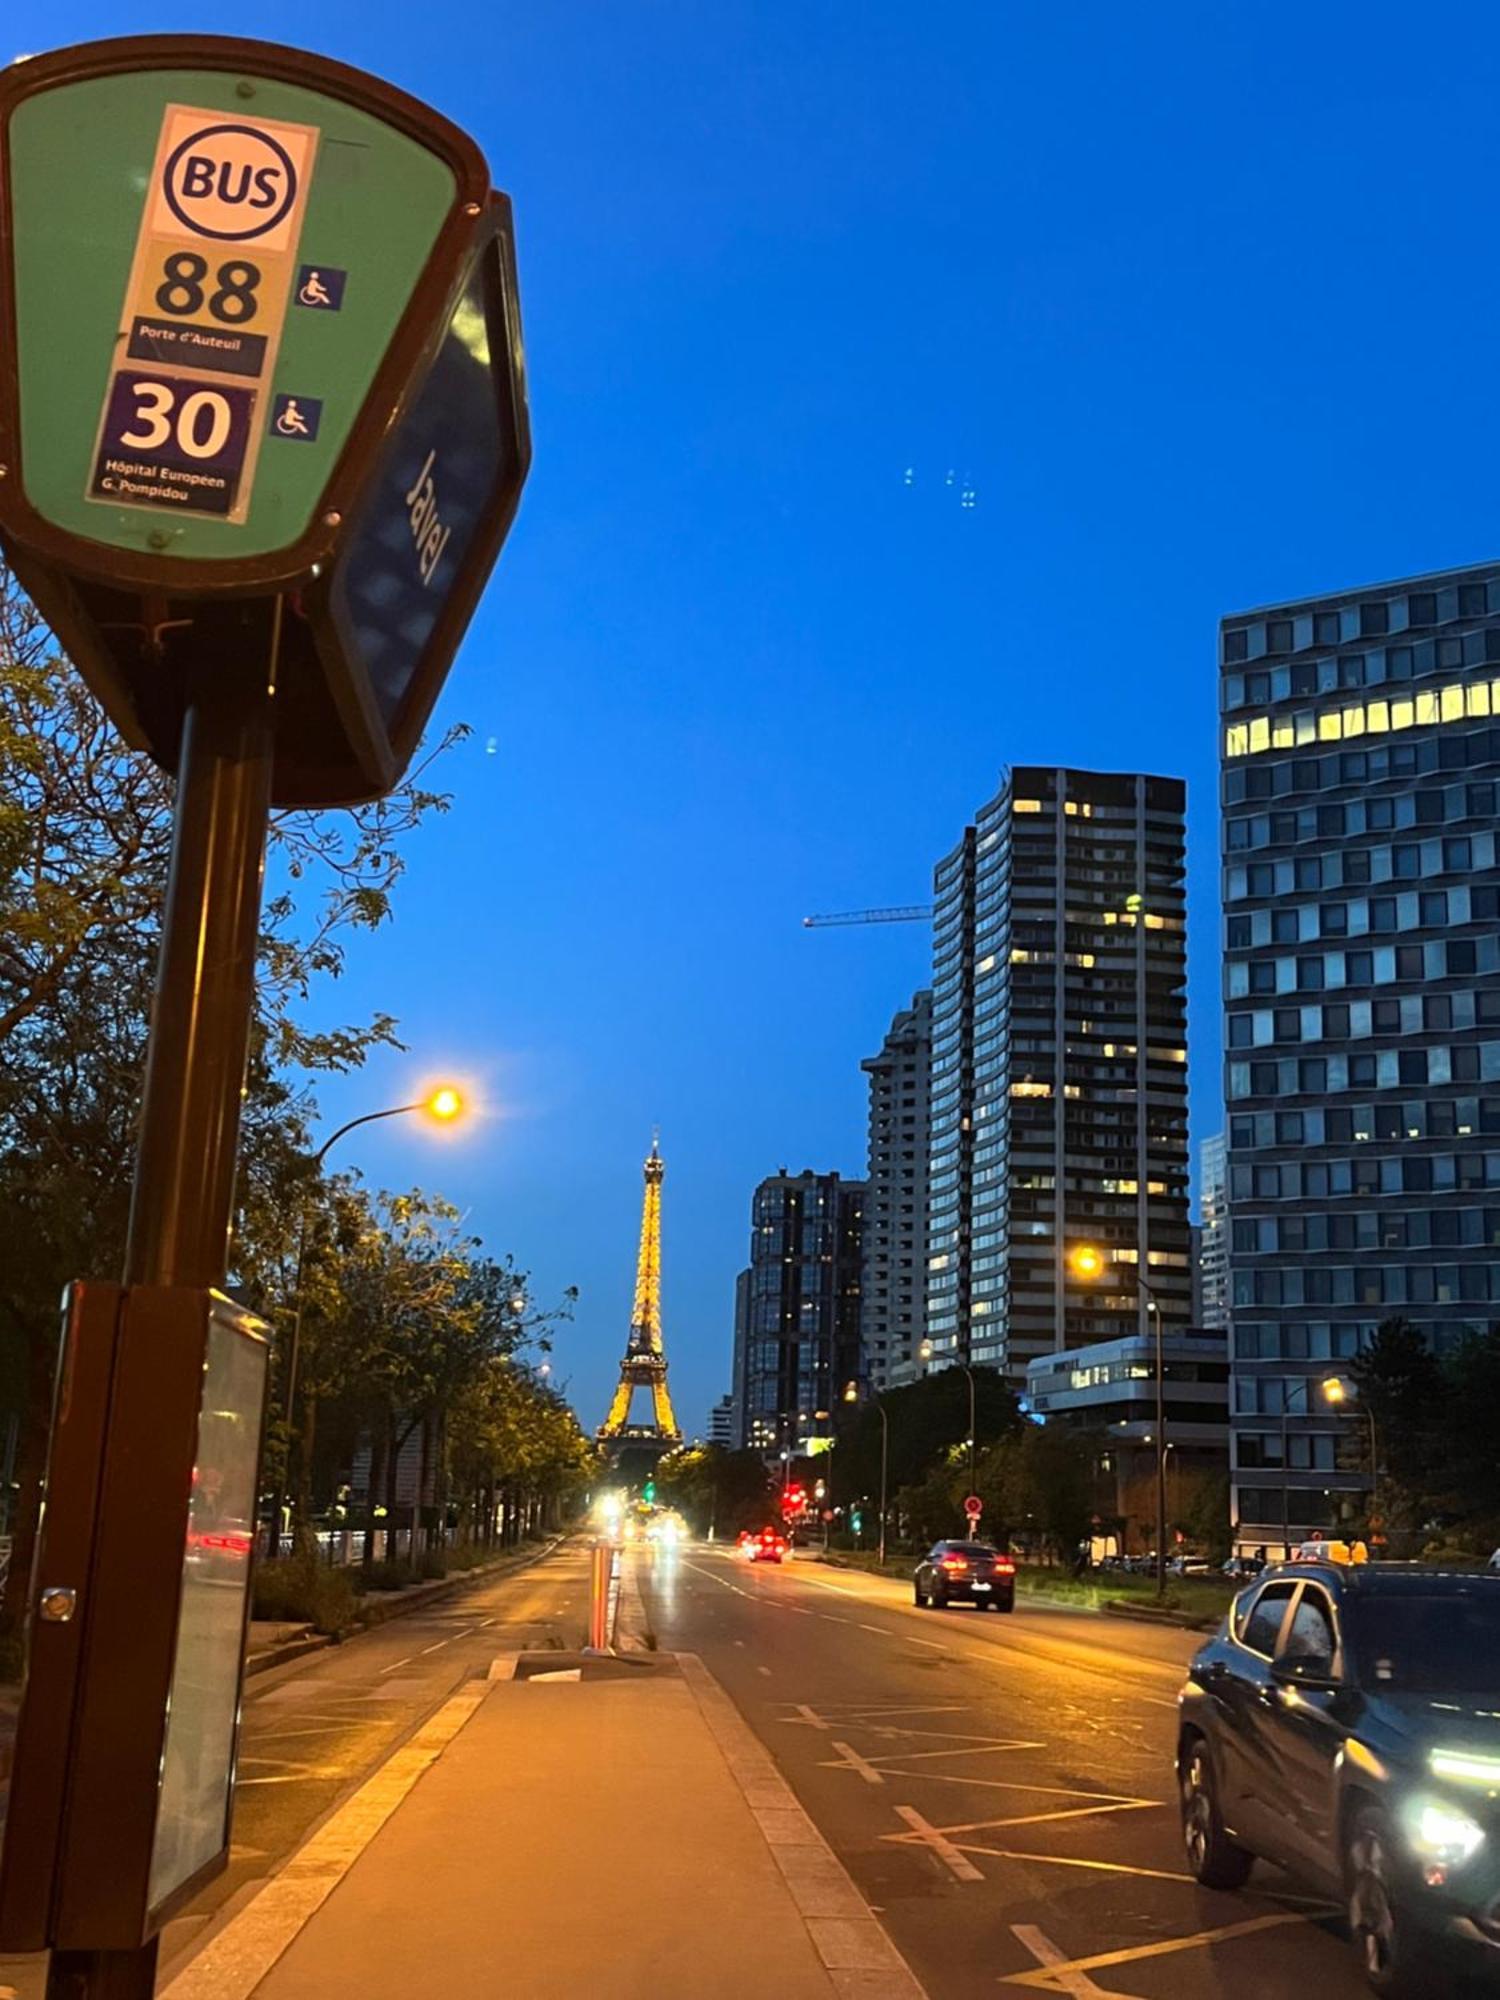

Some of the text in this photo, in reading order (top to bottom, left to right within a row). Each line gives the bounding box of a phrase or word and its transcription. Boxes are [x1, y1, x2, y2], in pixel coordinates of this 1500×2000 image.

[181, 155, 281, 209] BUS
[155, 252, 262, 324] 88
[139, 325, 242, 351] Porte d'Auteuil
[119, 382, 232, 458] 30
[105, 459, 157, 477] Hôpital
[119, 479, 189, 501] Pompidou
[406, 449, 451, 586] Javel
